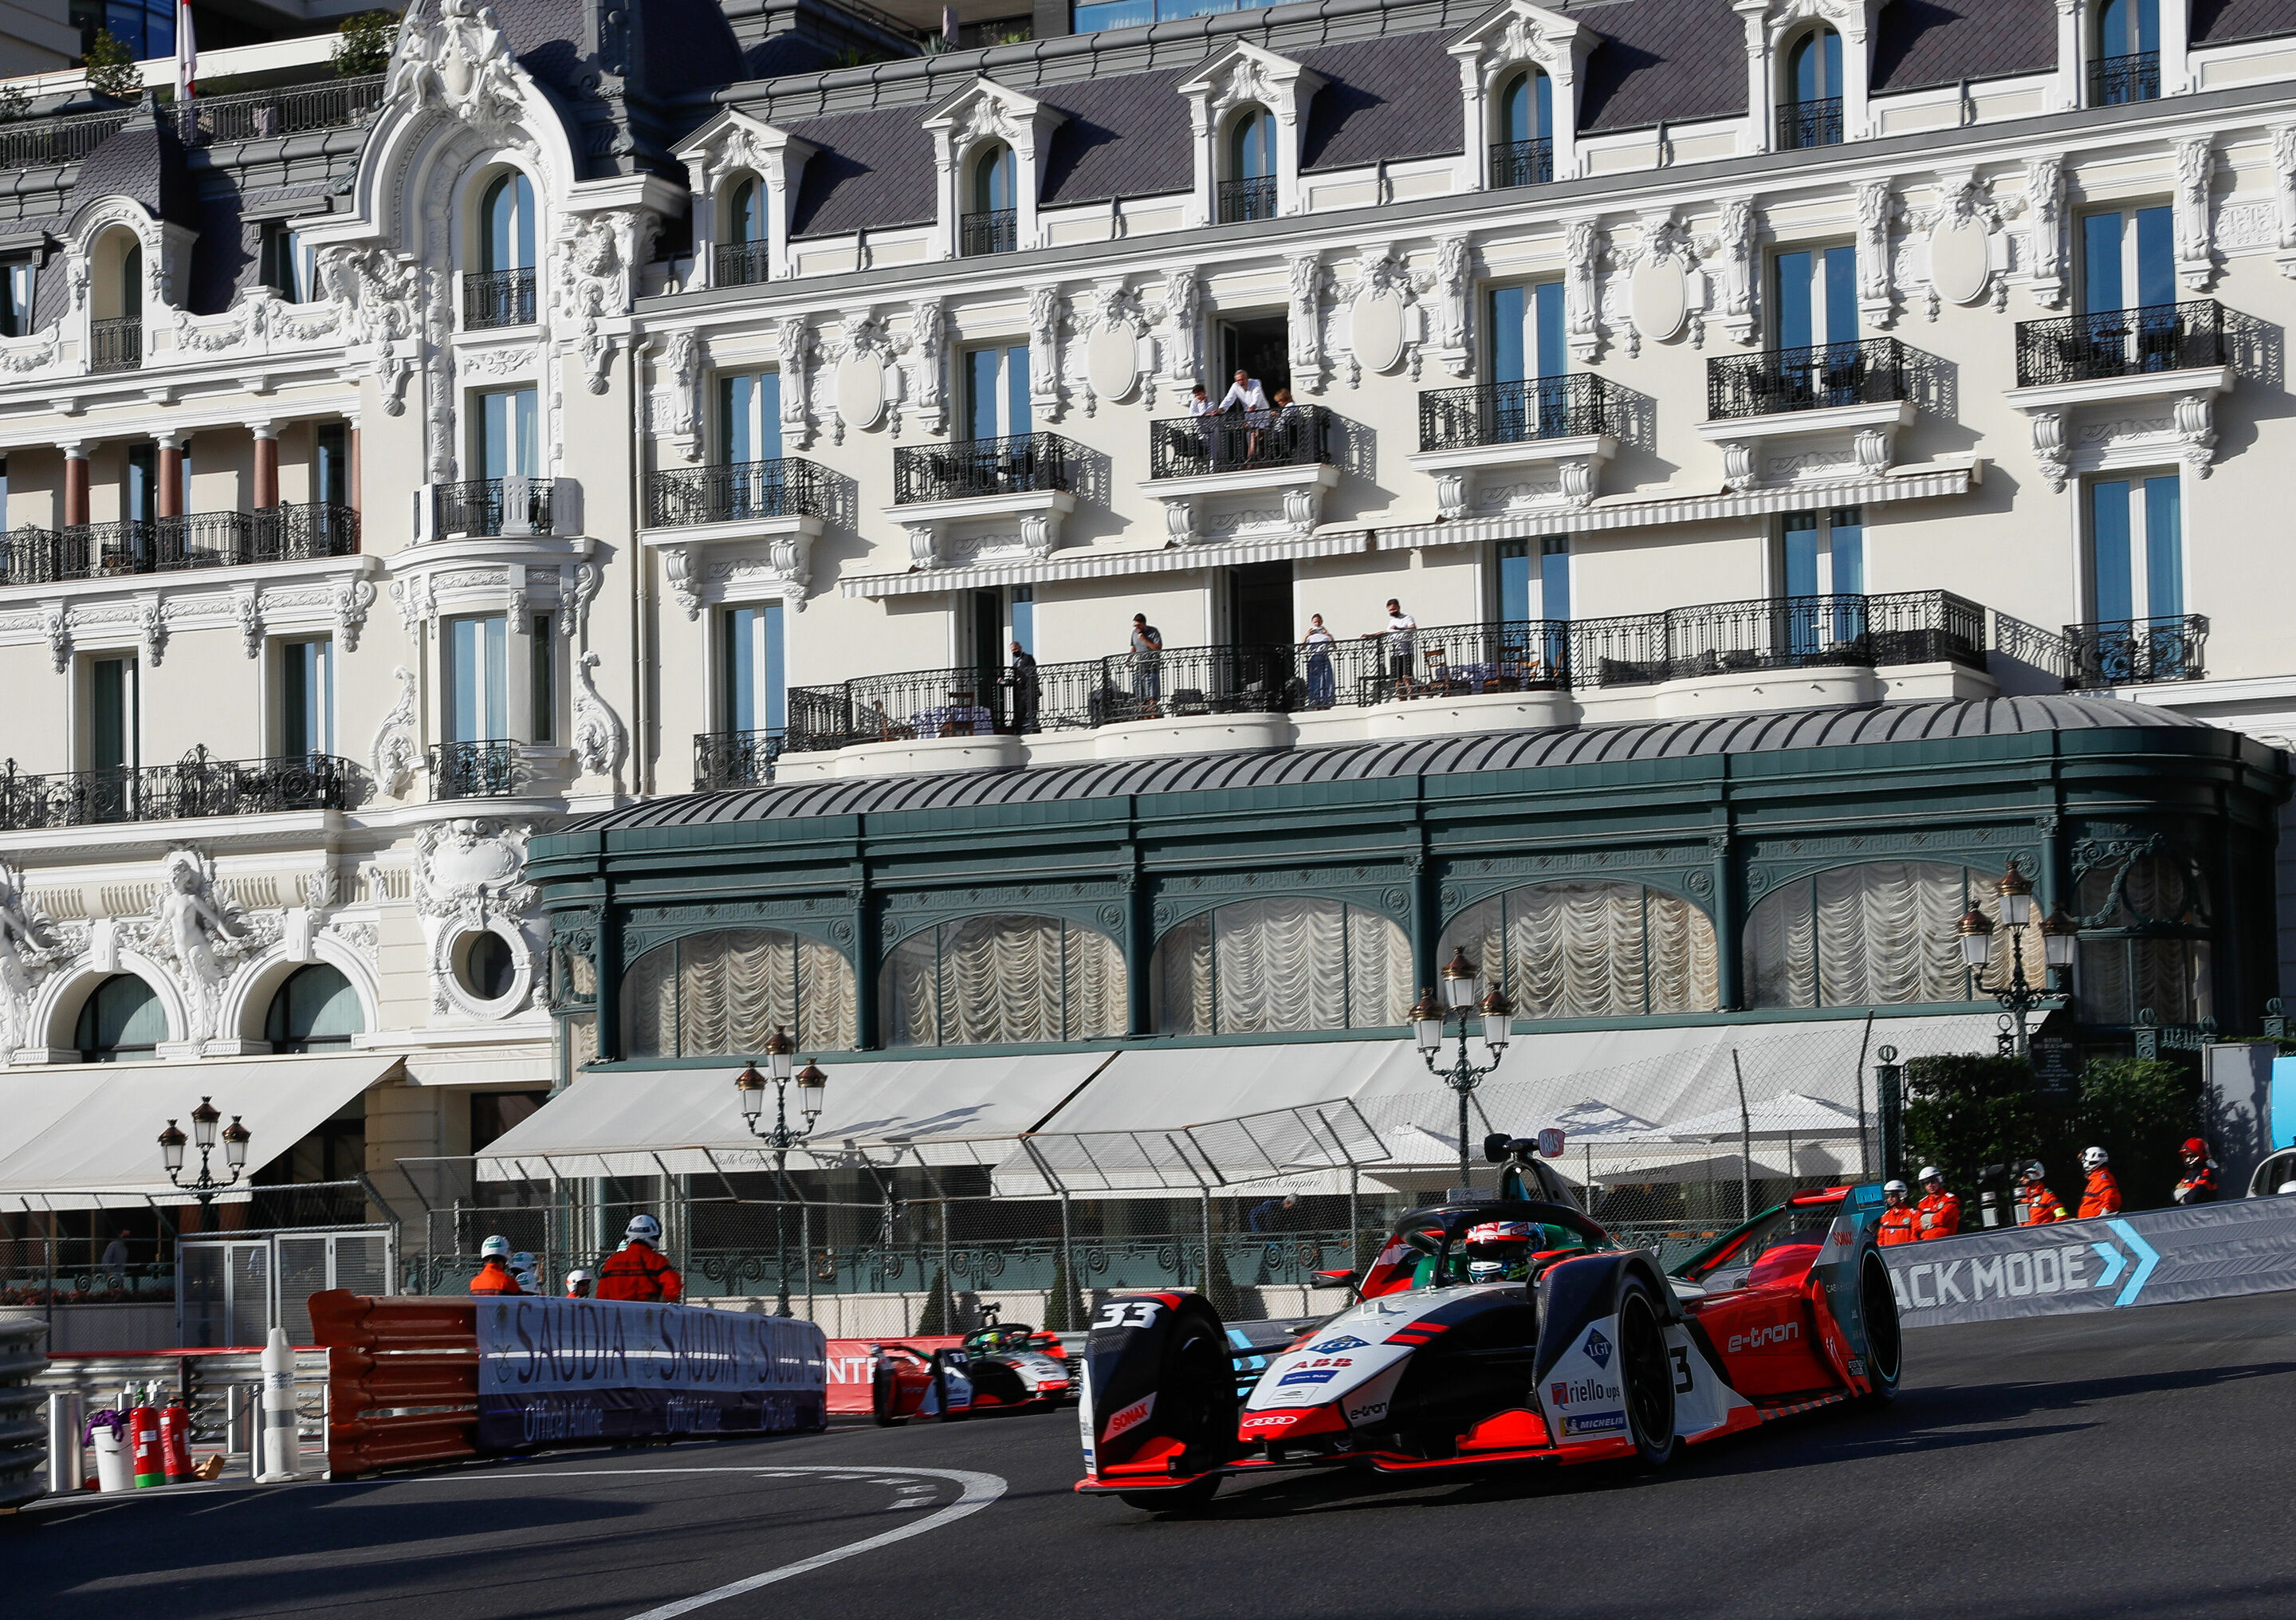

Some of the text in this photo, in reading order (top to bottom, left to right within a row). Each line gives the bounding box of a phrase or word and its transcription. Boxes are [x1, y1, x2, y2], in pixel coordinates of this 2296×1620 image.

[1543, 1133, 1559, 1152] RAS
[1589, 1158, 1673, 1181] Salle Empire
[1833, 1231, 1854, 1246] SONAX
[1971, 1244, 2089, 1301] MODE
[1091, 1302, 1163, 1330] 33
[517, 1300, 628, 1384] SAUDIA
[660, 1308, 738, 1384] SAUDIA
[1315, 1341, 1362, 1351] LGT
[1728, 1322, 1799, 1353] e-tron
[1588, 1342, 1610, 1357] LGT
[1284, 1358, 1353, 1372] ABB
[1570, 1378, 1621, 1403] riello ups
[1113, 1402, 1150, 1432] SONAX
[1350, 1402, 1387, 1421] e-tron
[1579, 1415, 1624, 1429] MICHELIN
